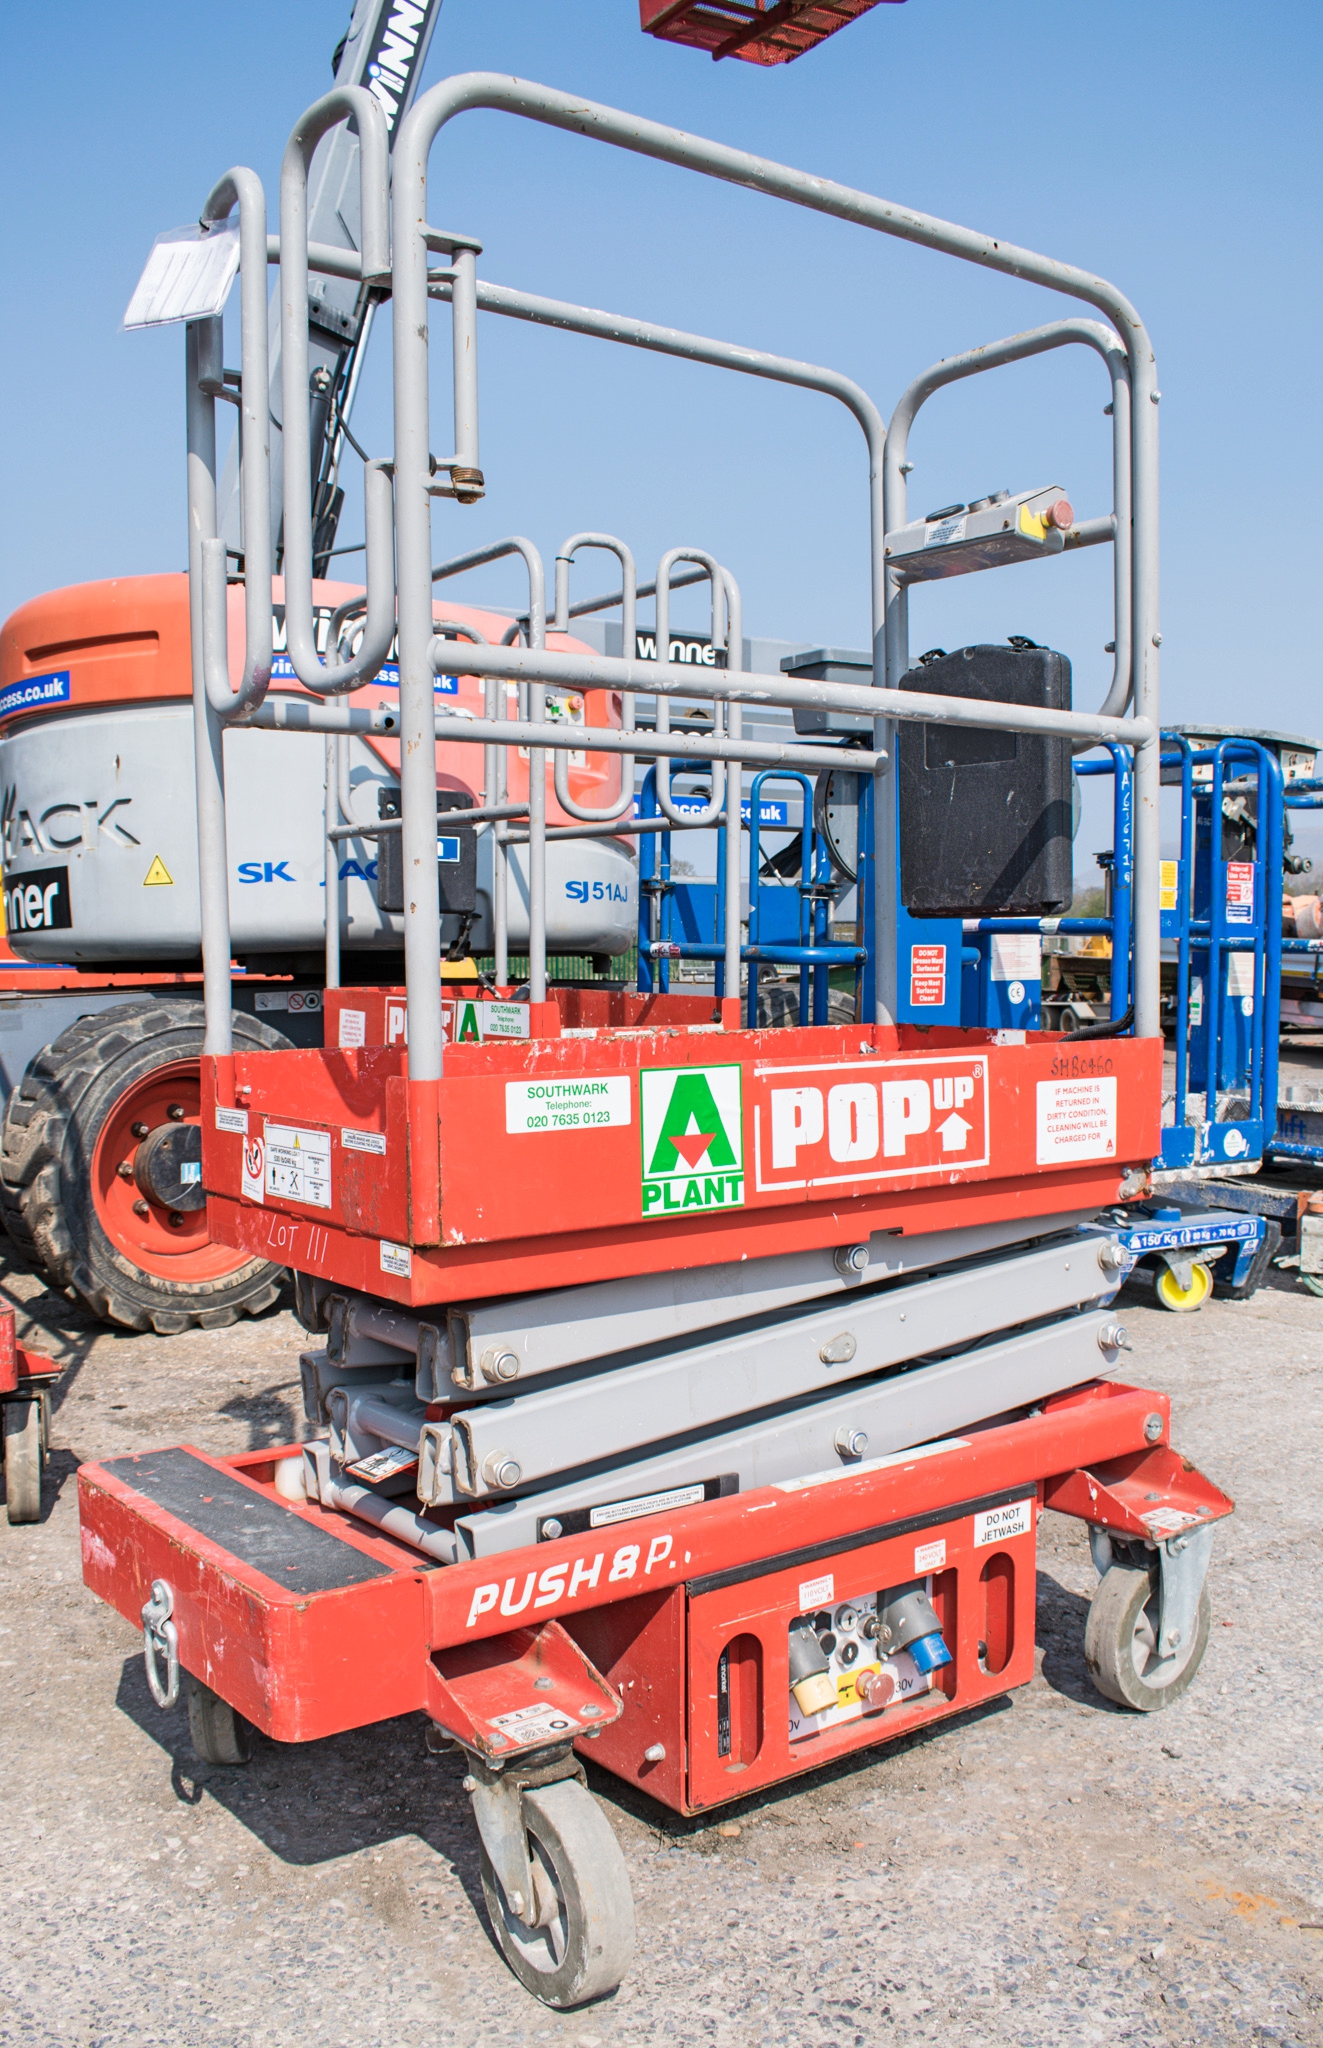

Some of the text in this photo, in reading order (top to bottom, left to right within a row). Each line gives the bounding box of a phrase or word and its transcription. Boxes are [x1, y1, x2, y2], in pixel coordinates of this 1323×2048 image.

[636, 636, 716, 667] wnne
[527, 1083, 609, 1099] SOUTHWARK
[1062, 1086, 1092, 1094] MACHINE
[1094, 1084, 1100, 1092] IS
[545, 1100, 592, 1111] Telephone:
[1056, 1096, 1099, 1107] RETURNED IN
[527, 1111, 610, 1128] 020 7635 0123
[771, 1076, 974, 1169] POP UP
[1046, 1112, 1066, 1121] DIRTY
[1046, 1122, 1082, 1132] CLEANING
[1082, 1121, 1098, 1129] WILL
[1054, 1132, 1100, 1144] CHARGED FOR
[642, 1176, 744, 1212] PLANT
[267, 1214, 299, 1252] LOT
[1164, 1234, 1178, 1246] Kg
[986, 1508, 1020, 1526] DO NOT
[982, 1521, 1024, 1542] JETWASH
[920, 1542, 940, 1552] WARNING
[466, 1552, 604, 1628] PUSH
[804, 1578, 828, 1589] WARNING
[895, 1678, 914, 1693] 30v
